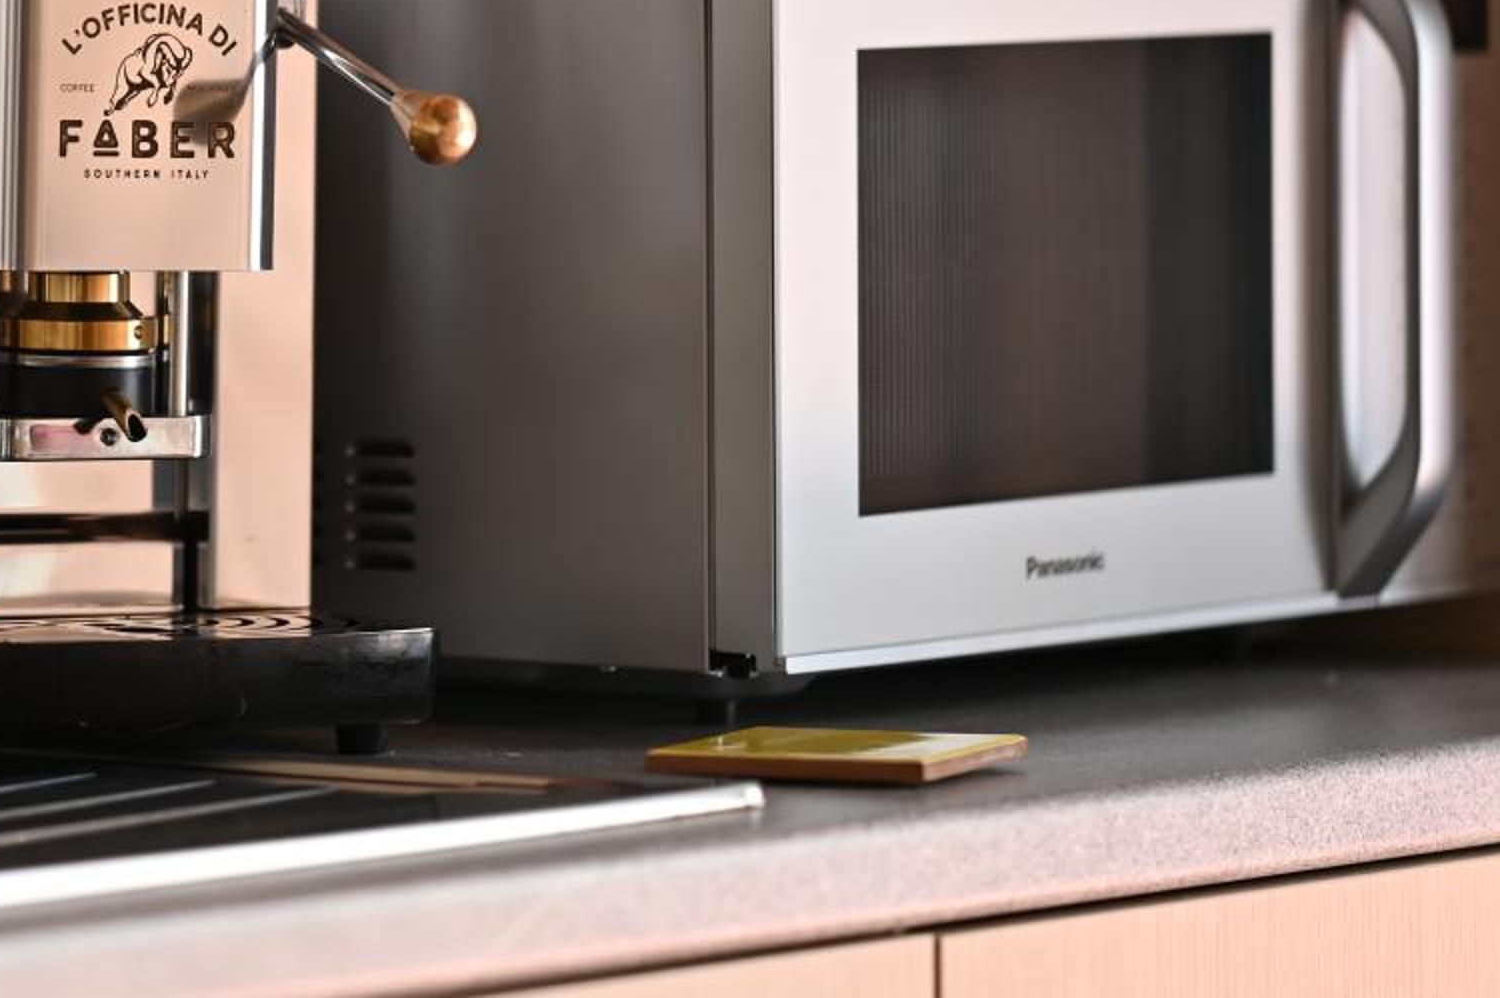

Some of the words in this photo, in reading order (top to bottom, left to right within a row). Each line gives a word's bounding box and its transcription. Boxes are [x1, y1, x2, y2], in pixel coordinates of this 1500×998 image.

[61, 2, 203, 55] L'OFFICINA
[208, 23, 237, 56] DI
[59, 83, 95, 93] COFFEE
[59, 119, 235, 159] FABER
[83, 169, 161, 180] SOUTHERN
[171, 169, 209, 180] ITALY
[1026, 548, 1104, 580] Panasonic
